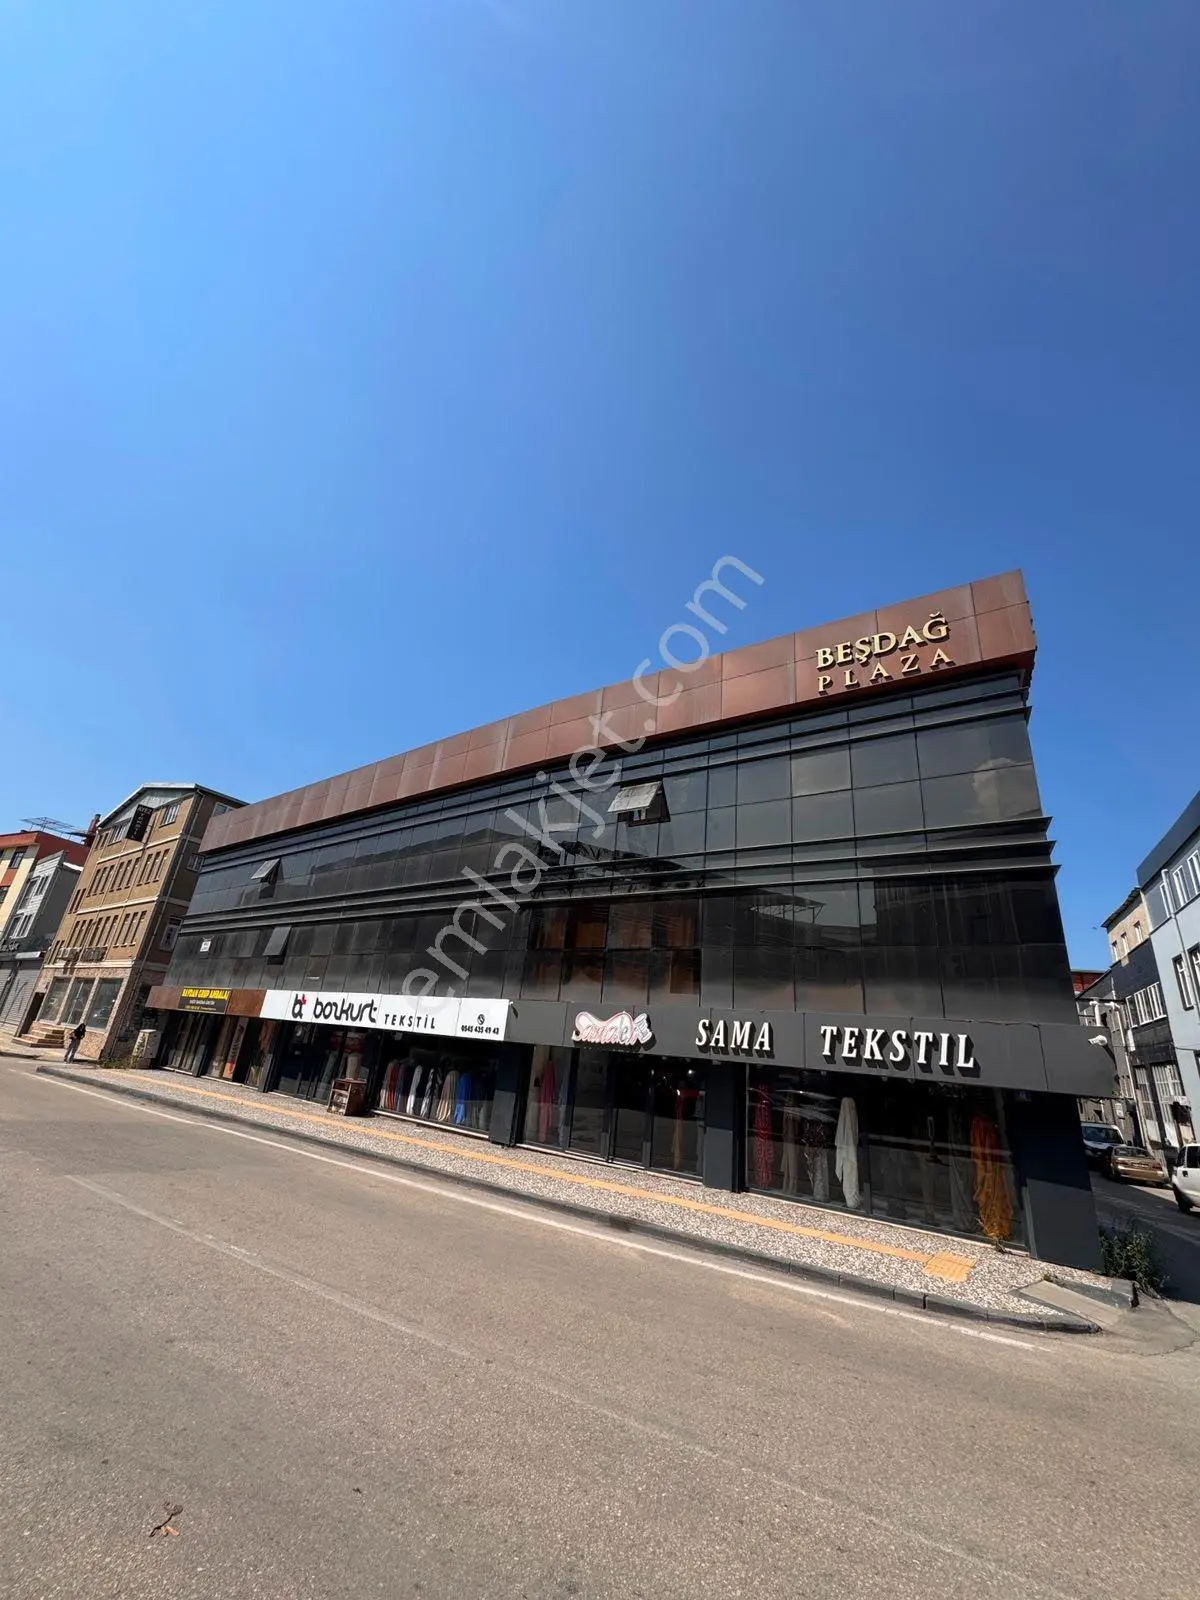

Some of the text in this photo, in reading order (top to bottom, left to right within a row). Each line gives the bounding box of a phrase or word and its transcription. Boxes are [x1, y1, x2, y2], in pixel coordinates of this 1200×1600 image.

[815, 611, 950, 670] BEŞDAĞ
[817, 648, 953, 694] PLAZA
[313, 997, 378, 1024] bozkurt
[384, 1013, 436, 1030] TEKSTİL
[695, 1018, 975, 1069] SAMA TEKSTIL
